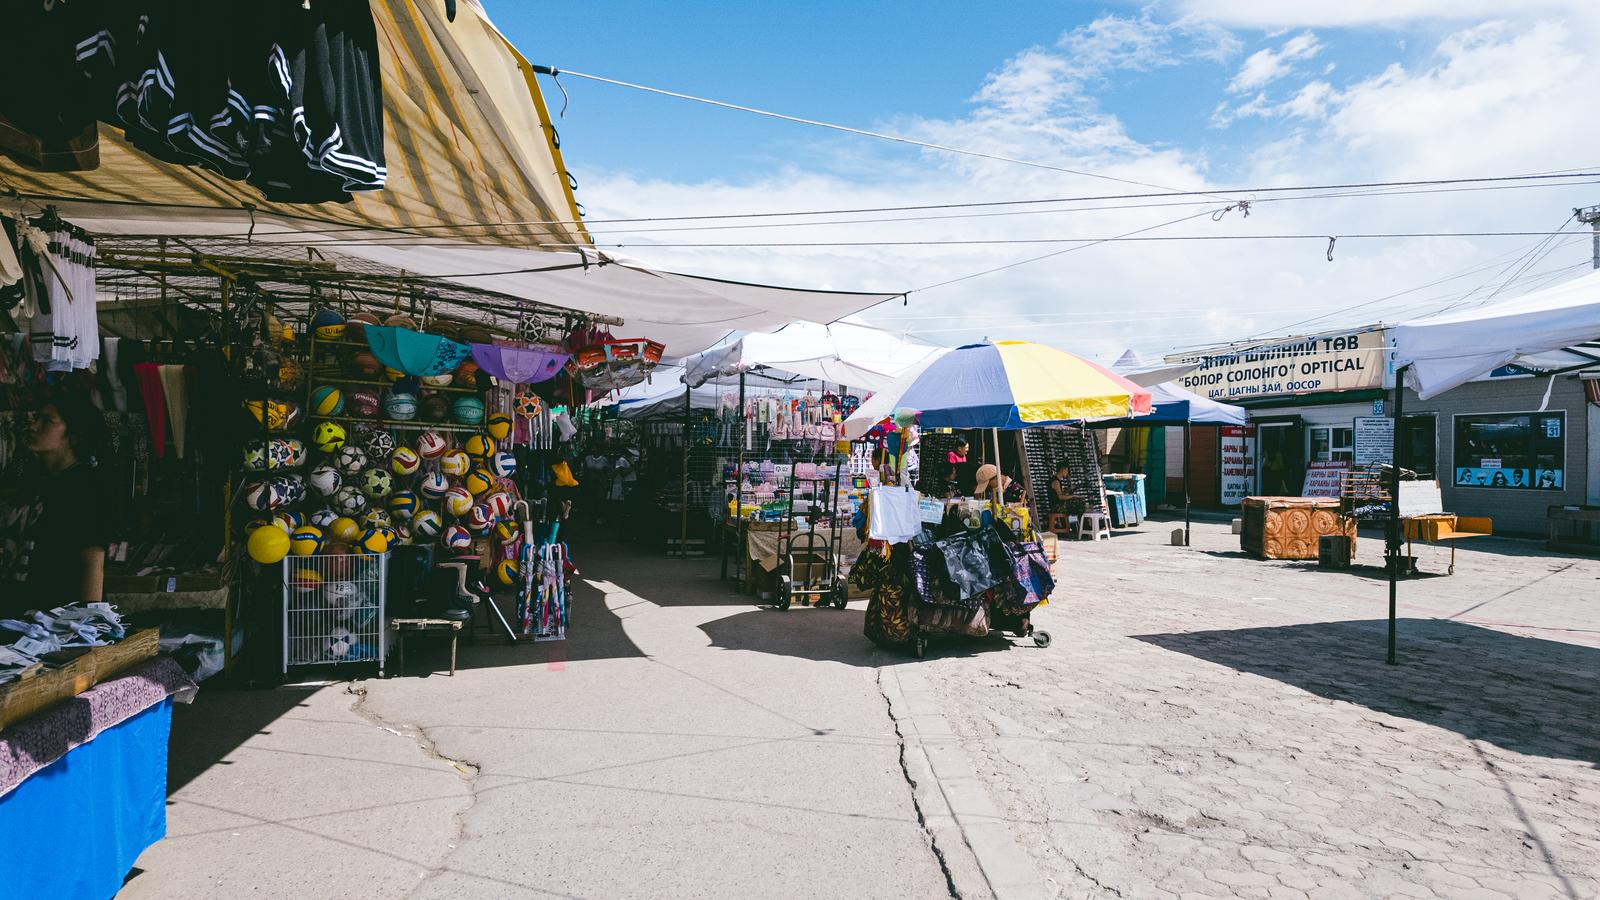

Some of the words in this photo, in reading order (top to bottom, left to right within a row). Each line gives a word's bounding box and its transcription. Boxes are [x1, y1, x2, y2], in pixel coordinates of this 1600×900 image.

[1323, 335, 1359, 353] ТӨВ
[1301, 357, 1364, 375] OPTICAL
[1208, 388, 1227, 398] ЦАГ,
[1229, 385, 1260, 396] ЦАГНЫ
[1261, 381, 1283, 393] ЗАЙ,
[1286, 380, 1321, 391] ООСОР
[1548, 427, 1559, 437] 31
